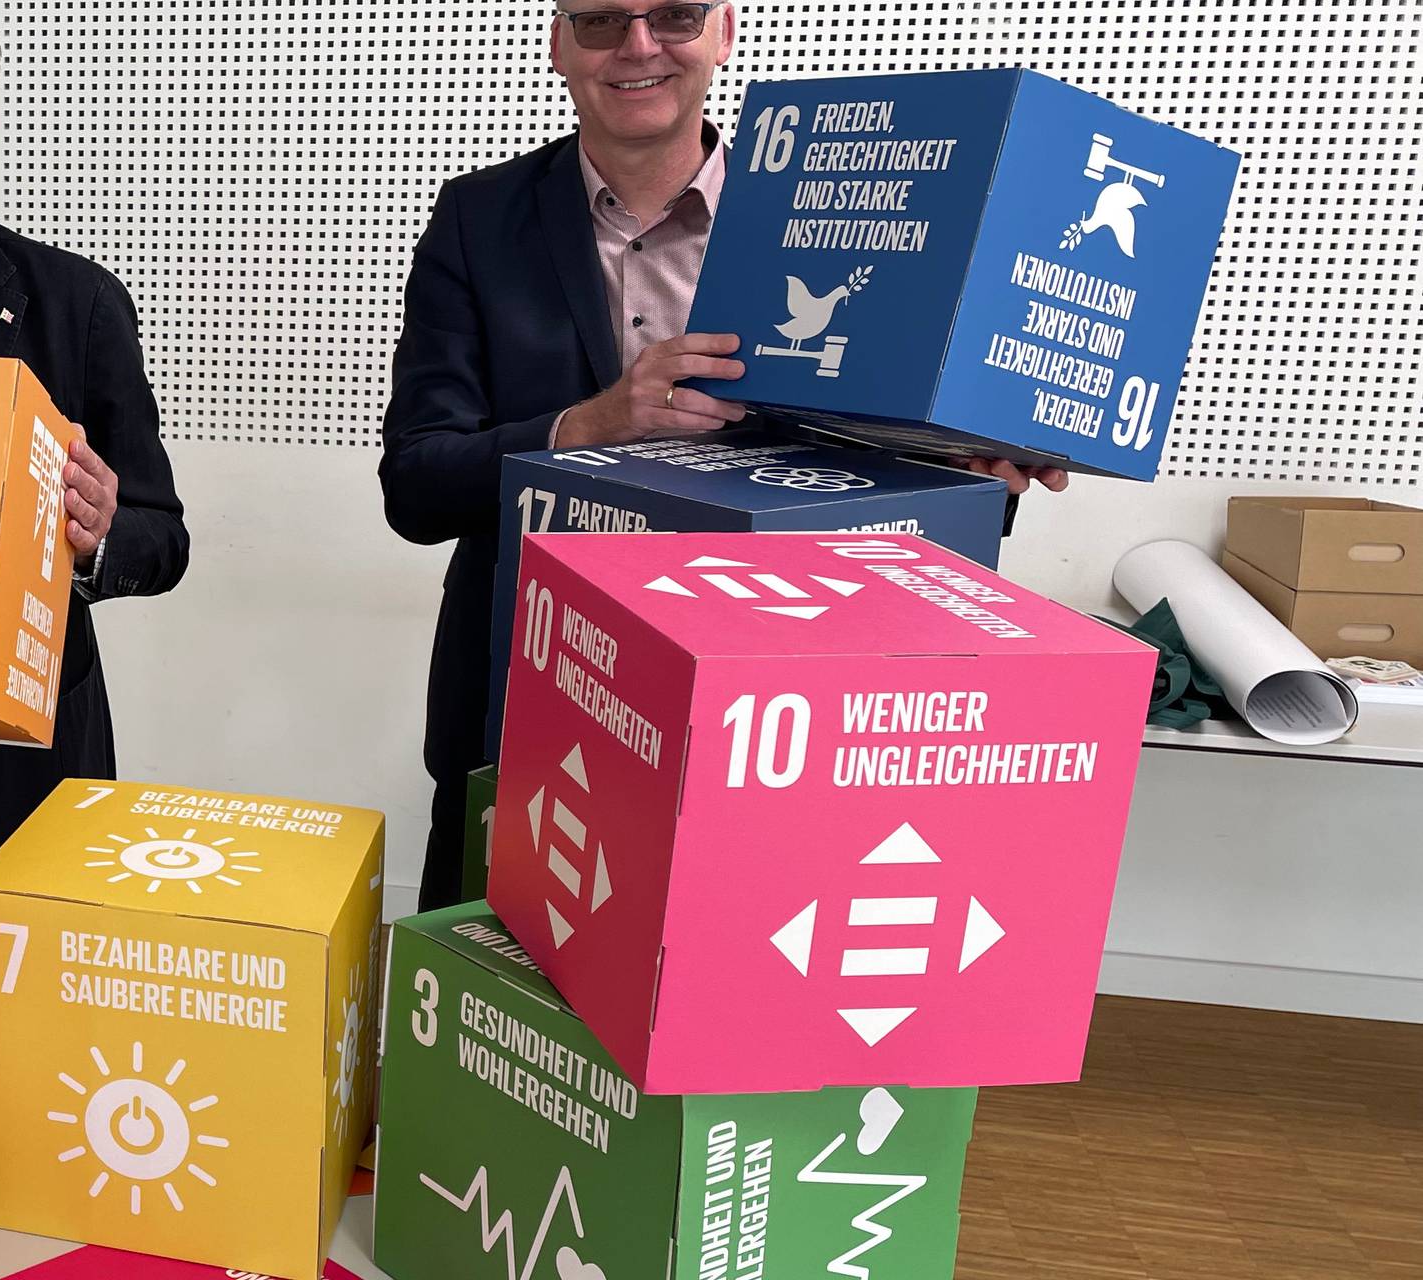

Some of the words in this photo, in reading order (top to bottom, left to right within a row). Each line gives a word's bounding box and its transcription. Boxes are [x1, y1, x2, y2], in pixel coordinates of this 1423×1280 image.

[748, 105, 801, 174] 16
[811, 100, 896, 134] FRIEDEN,
[802, 139, 957, 173] GERECHTIGKEIT
[792, 182, 837, 212] UND
[838, 180, 913, 212] STARKE
[781, 220, 929, 253] INSTITUTIONEN
[1010, 252, 1137, 321] INSTITUTIONEN
[1021, 300, 1085, 348] STARKE
[1084, 321, 1127, 361] UND
[982, 333, 1114, 399] GERECHTIGKEIT
[1032, 387, 1106, 439] FRIEDEN,
[1111, 374, 1160, 451] 16
[553, 451, 621, 466] 17
[517, 487, 556, 532] 17
[816, 540, 921, 559] 10
[864, 565, 1037, 639] UNGLEICHHEITEN
[912, 565, 1016, 603] WENIGER
[522, 578, 553, 673] 10
[562, 603, 618, 680] WENIGER
[555, 650, 663, 771] UNGLEICHHEITEN
[842, 691, 989, 734] WENIGER
[722, 693, 812, 789] 10
[832, 741, 1099, 788] UNGLEICHHEITEN
[73, 786, 116, 810] 7
[130, 802, 236, 825] SAUBERE
[238, 813, 340, 838] ENERGIE
[139, 790, 290, 820] BEZAHLBARE
[292, 808, 344, 825] UND
[60, 930, 225, 984] BEZAHLBARE
[231, 953, 286, 991] UND
[451, 922, 509, 948] UND
[60, 972, 176, 1017] SAUBERE
[180, 987, 287, 1033] ENERGIE
[411, 968, 439, 1047] 3
[460, 991, 587, 1091] GESUNDHEIT
[589, 1063, 637, 1120] UND
[458, 1033, 610, 1154] WOHLERGEHEN
[706, 1120, 737, 1186] UND
[698, 1188, 734, 1280] NDHEIT
[734, 1138, 773, 1280] LERGEHEN
